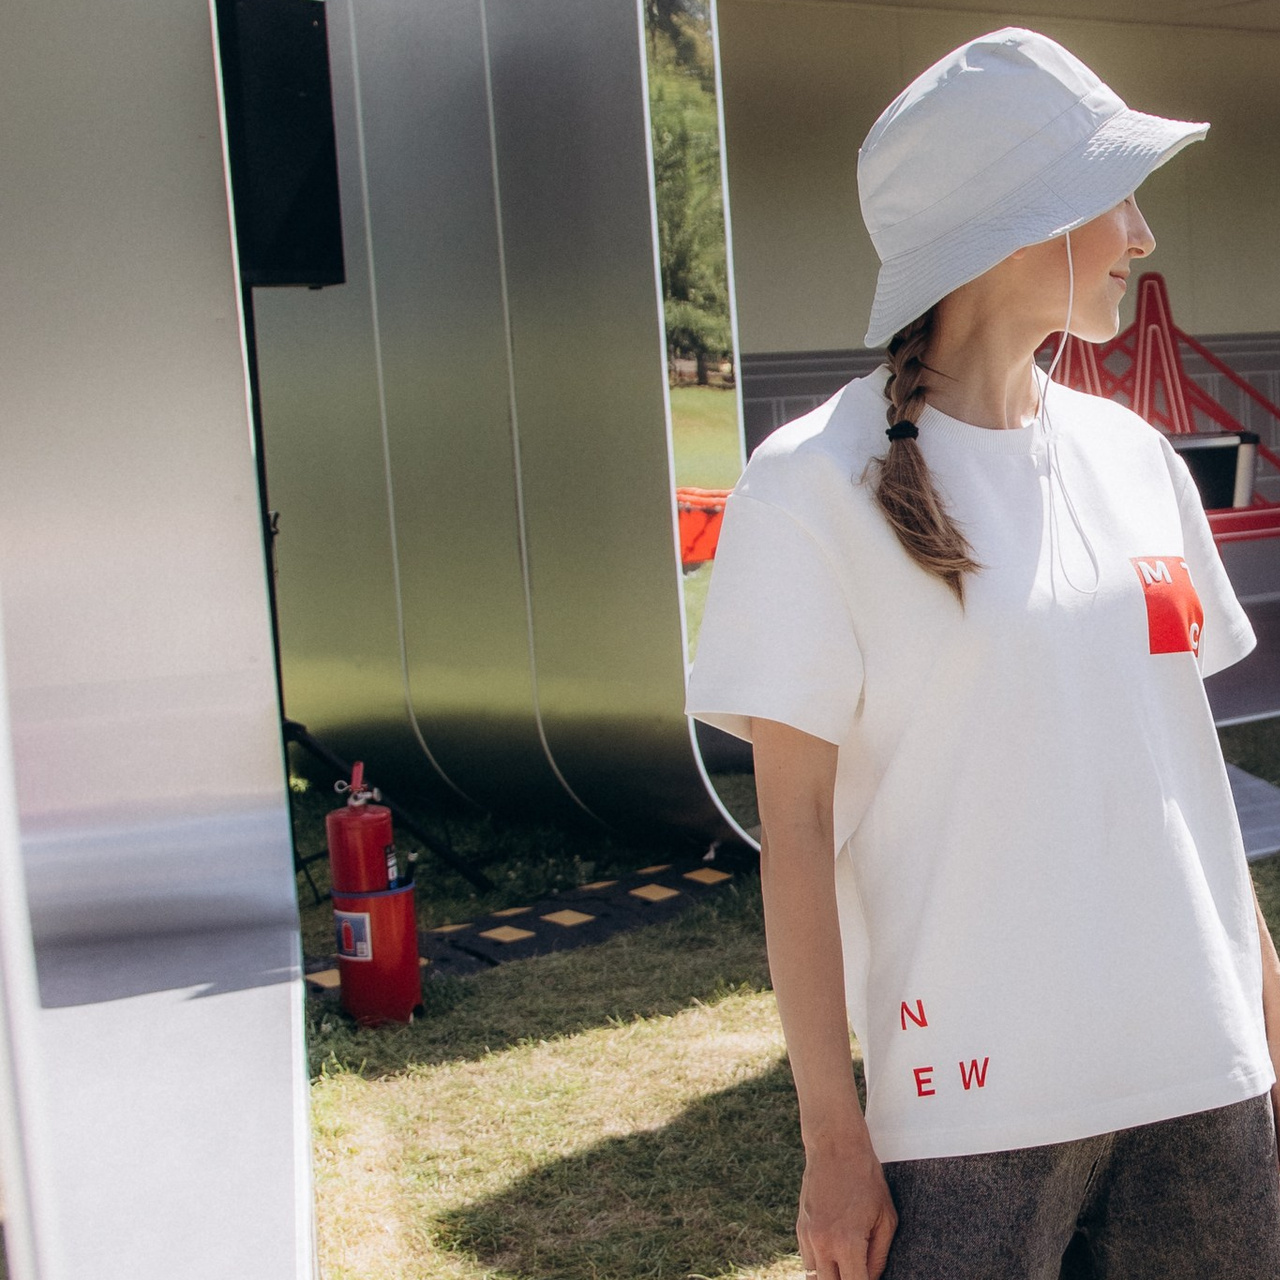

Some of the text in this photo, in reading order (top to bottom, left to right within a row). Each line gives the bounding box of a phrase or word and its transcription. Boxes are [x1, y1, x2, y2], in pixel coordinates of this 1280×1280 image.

[1137, 560, 1173, 585] М
[901, 999, 928, 1031] N
[913, 1056, 990, 1097] E W
